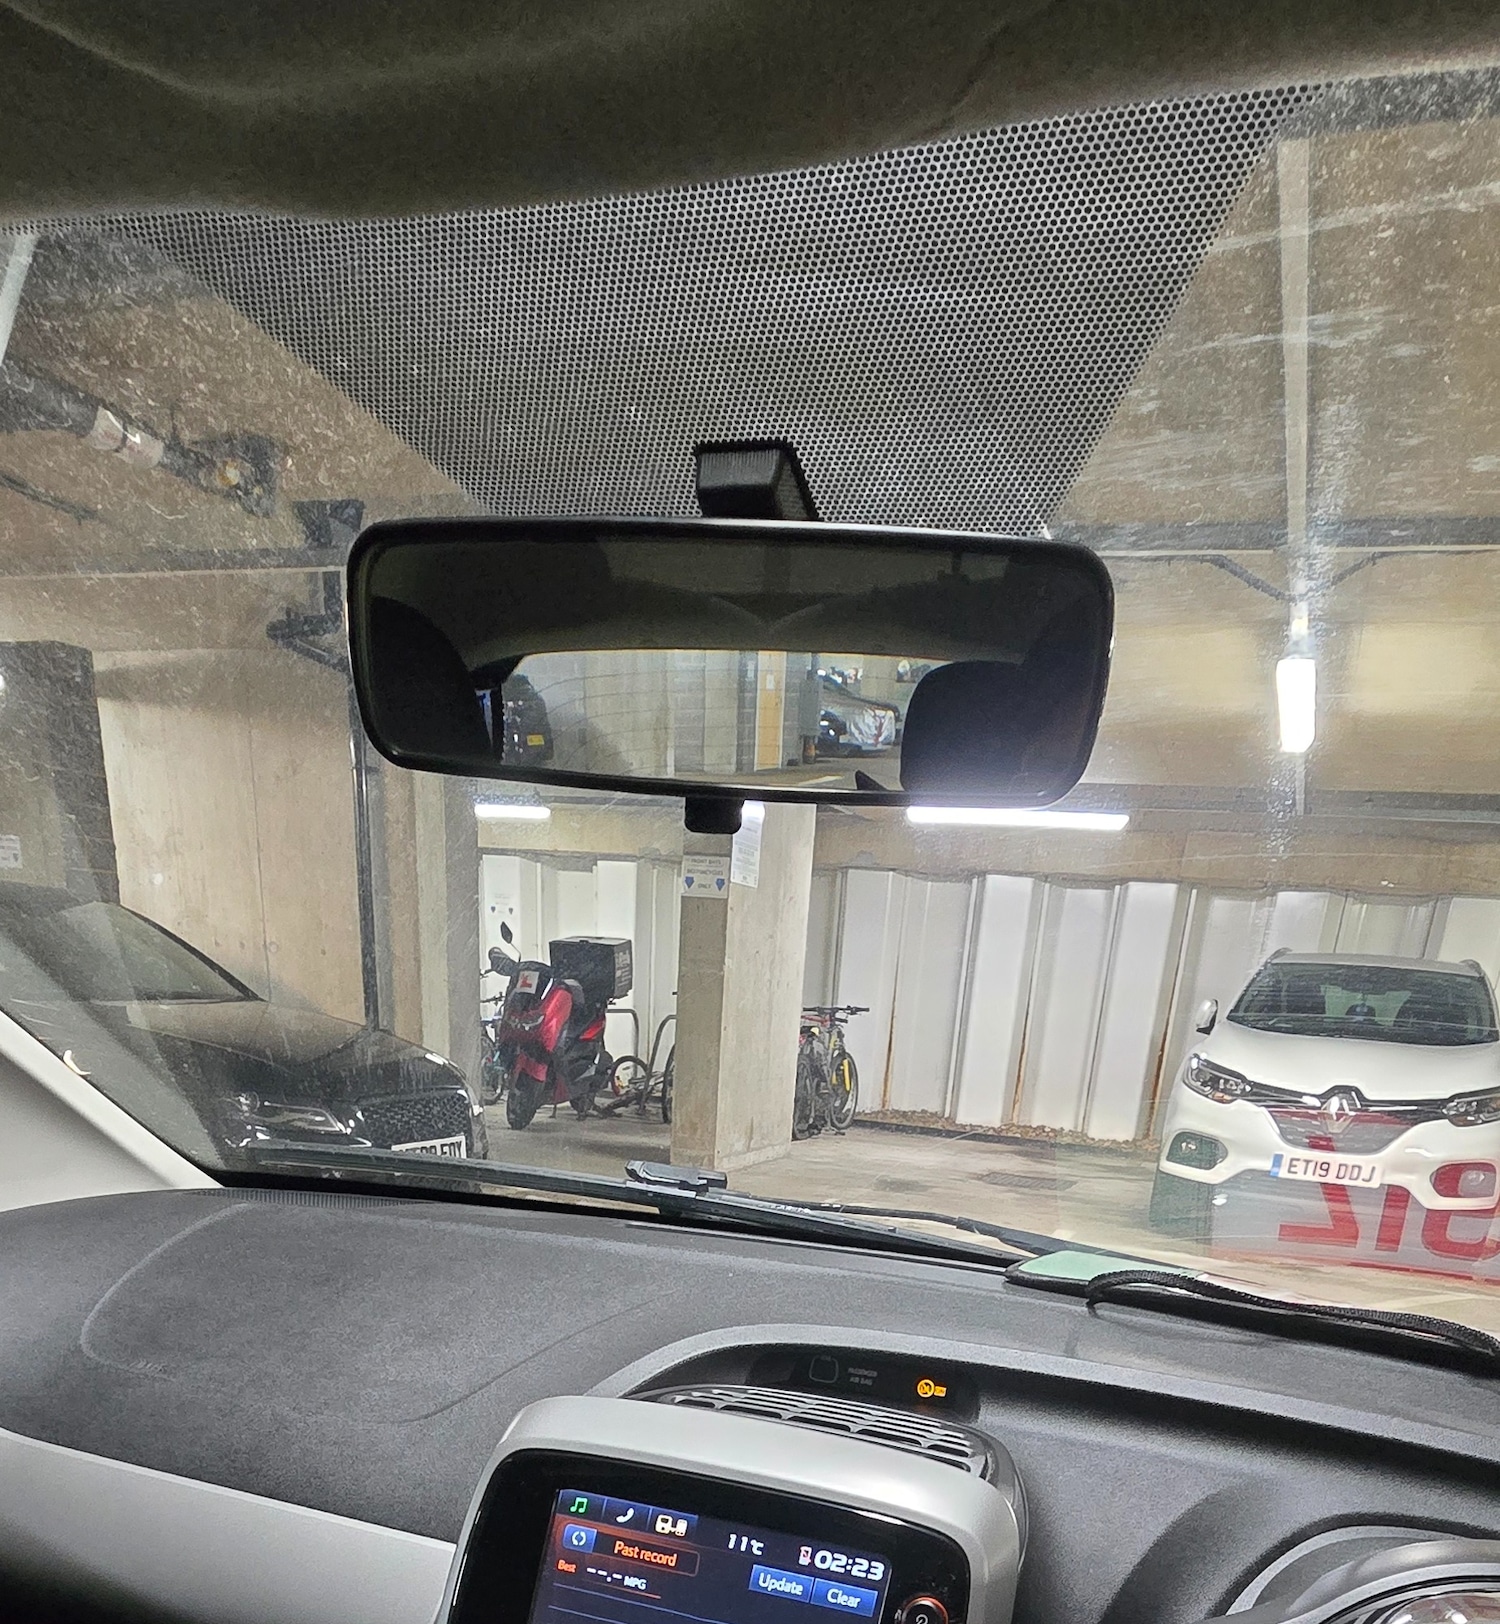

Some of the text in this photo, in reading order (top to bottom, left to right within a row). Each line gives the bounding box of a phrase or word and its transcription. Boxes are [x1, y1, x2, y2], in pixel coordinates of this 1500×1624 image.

[1287, 1157, 1376, 1183] ET19 DDJ
[613, 1540, 677, 1567] Past record
[814, 1550, 885, 1581] 02:23
[557, 1559, 576, 1574] Best
[623, 1575, 647, 1590] MPG
[758, 1572, 803, 1597] Update
[826, 1588, 861, 1608] Clear
